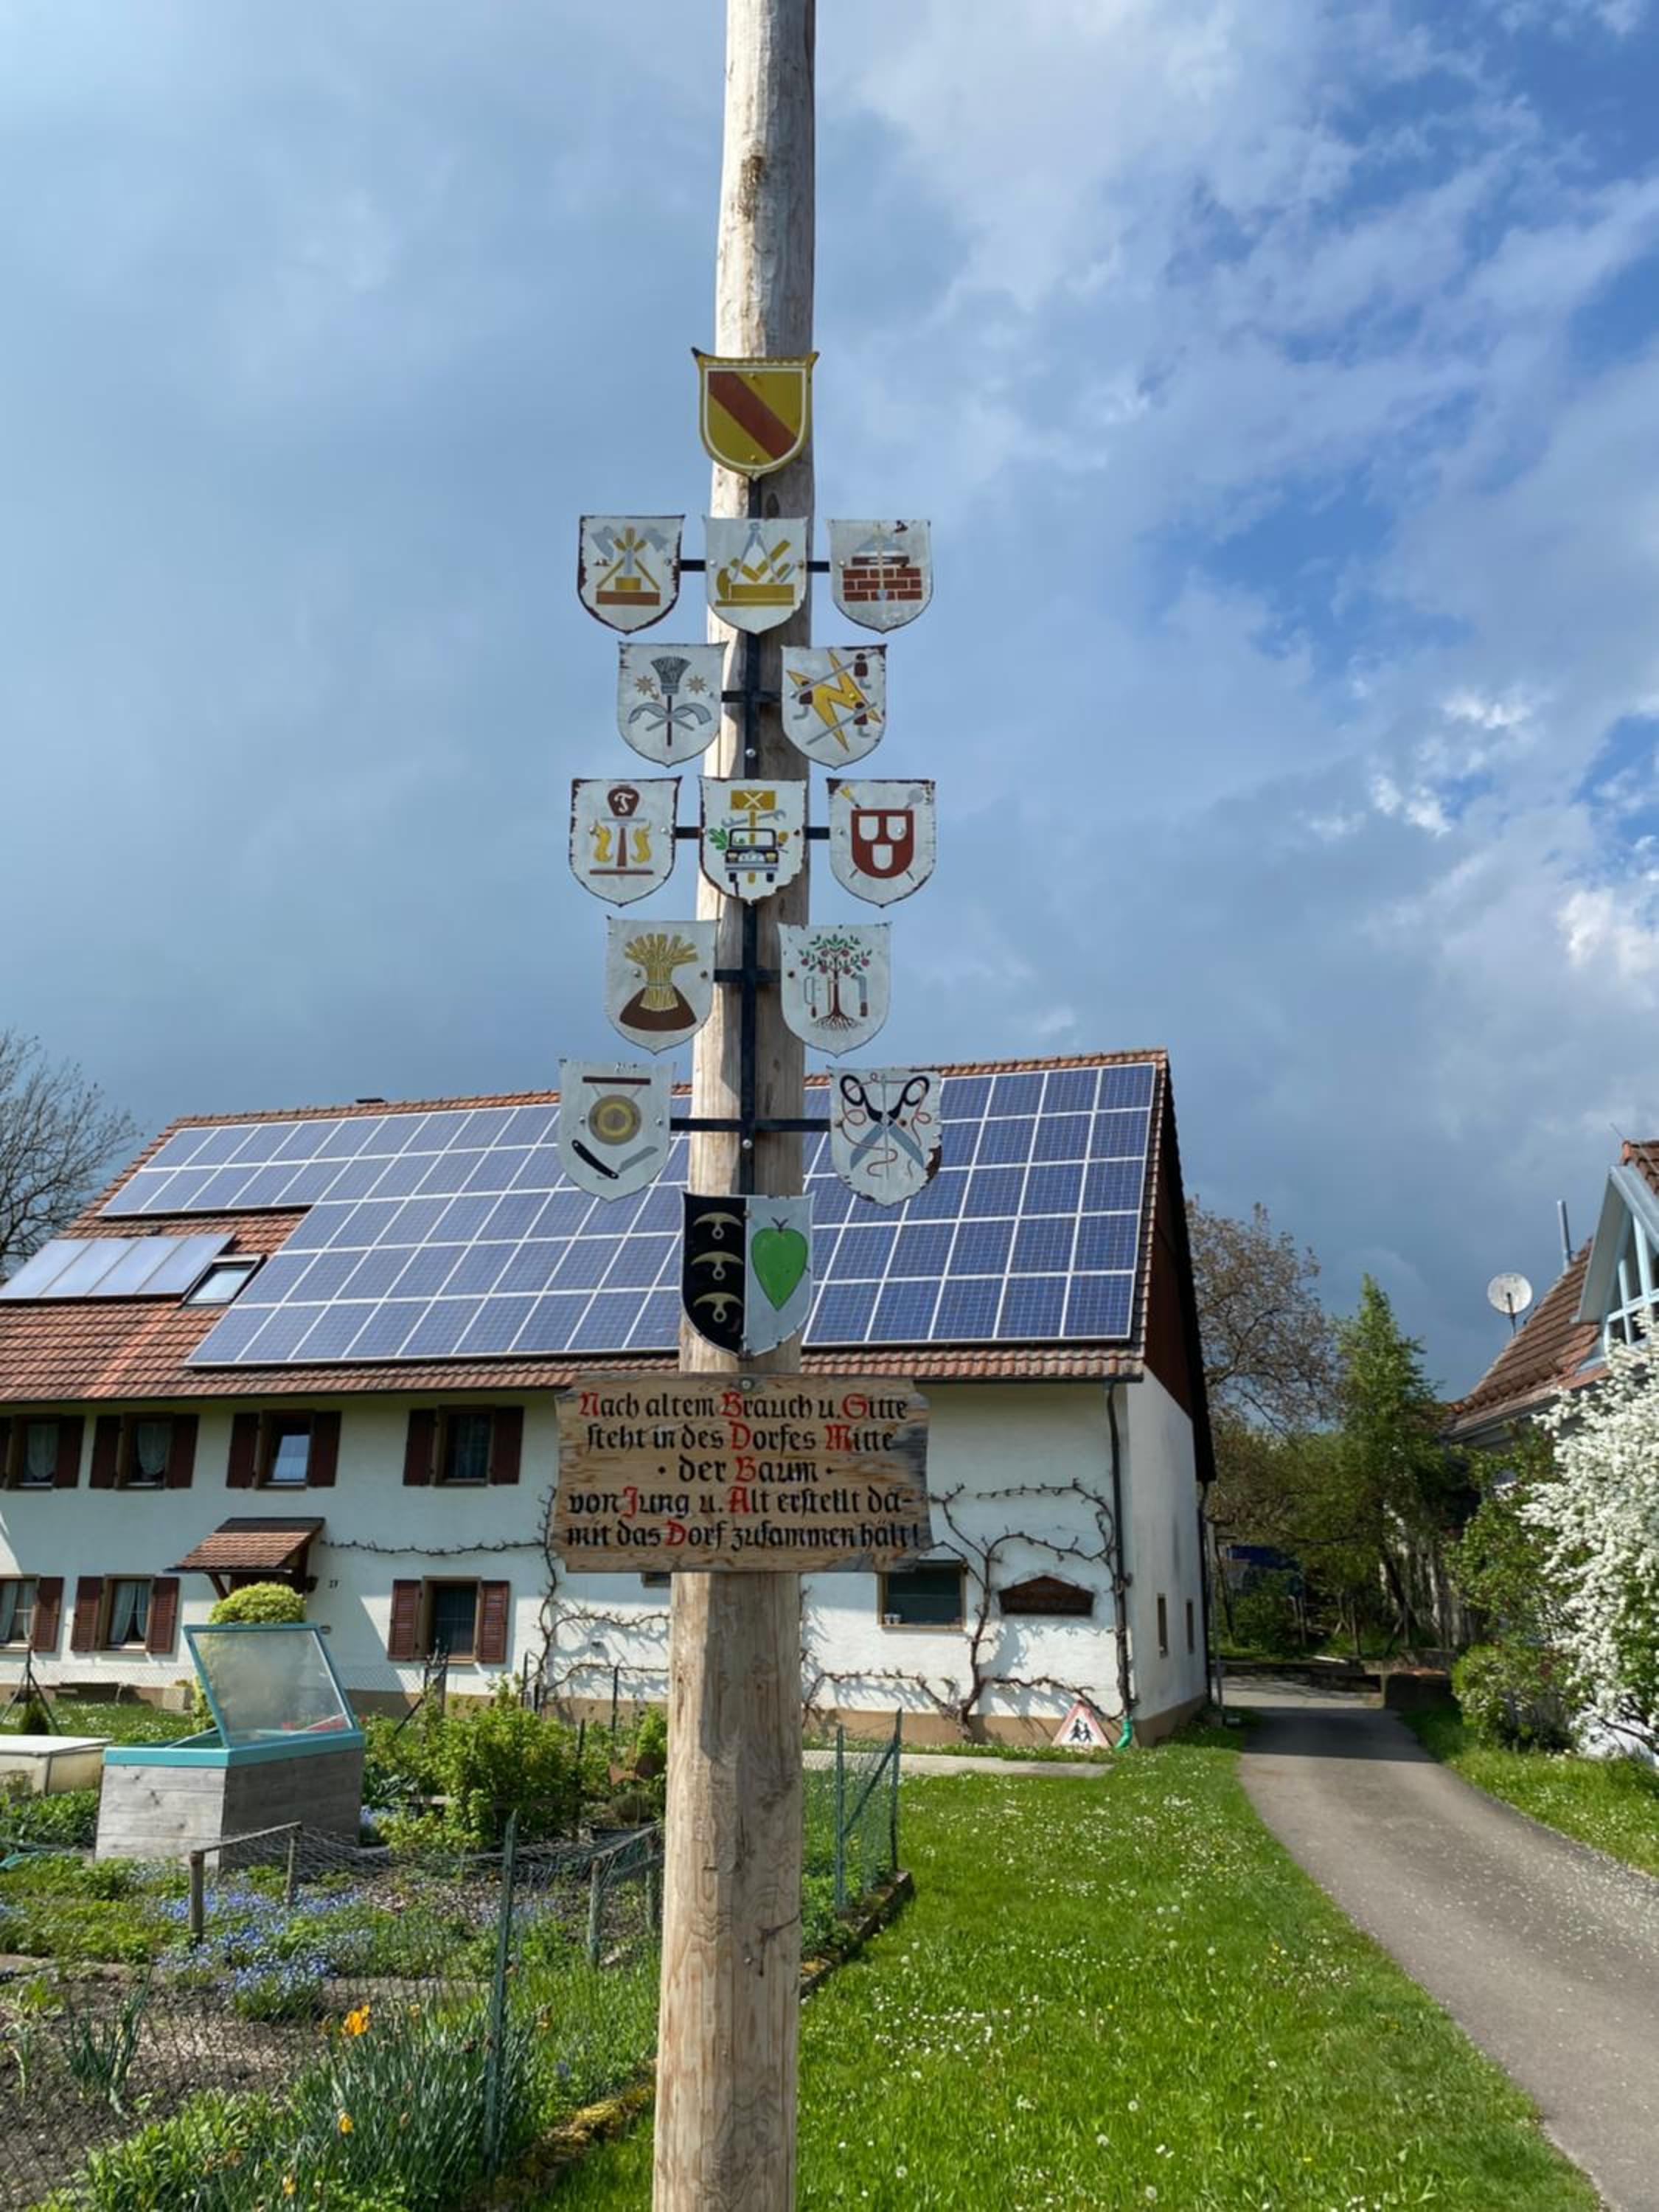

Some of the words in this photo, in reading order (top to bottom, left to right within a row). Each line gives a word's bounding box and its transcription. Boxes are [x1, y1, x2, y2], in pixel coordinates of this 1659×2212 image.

[578, 1391, 640, 1419] Nach
[646, 1393, 715, 1417] altem
[720, 1391, 812, 1419] Brauch
[841, 1393, 908, 1419] Sitte
[653, 1425, 675, 1450] in
[681, 1424, 724, 1450] des
[728, 1421, 816, 1455] Dorfes
[824, 1423, 894, 1451] Mitte
[678, 1454, 726, 1482] der
[734, 1456, 818, 1484] Baum
[568, 1493, 620, 1514] von
[623, 1486, 689, 1519] Jung
[698, 1495, 723, 1512] u.
[727, 1486, 769, 1513] Alt
[567, 1524, 611, 1546] mit
[617, 1520, 661, 1546] das
[664, 1520, 728, 1549] Dorf
